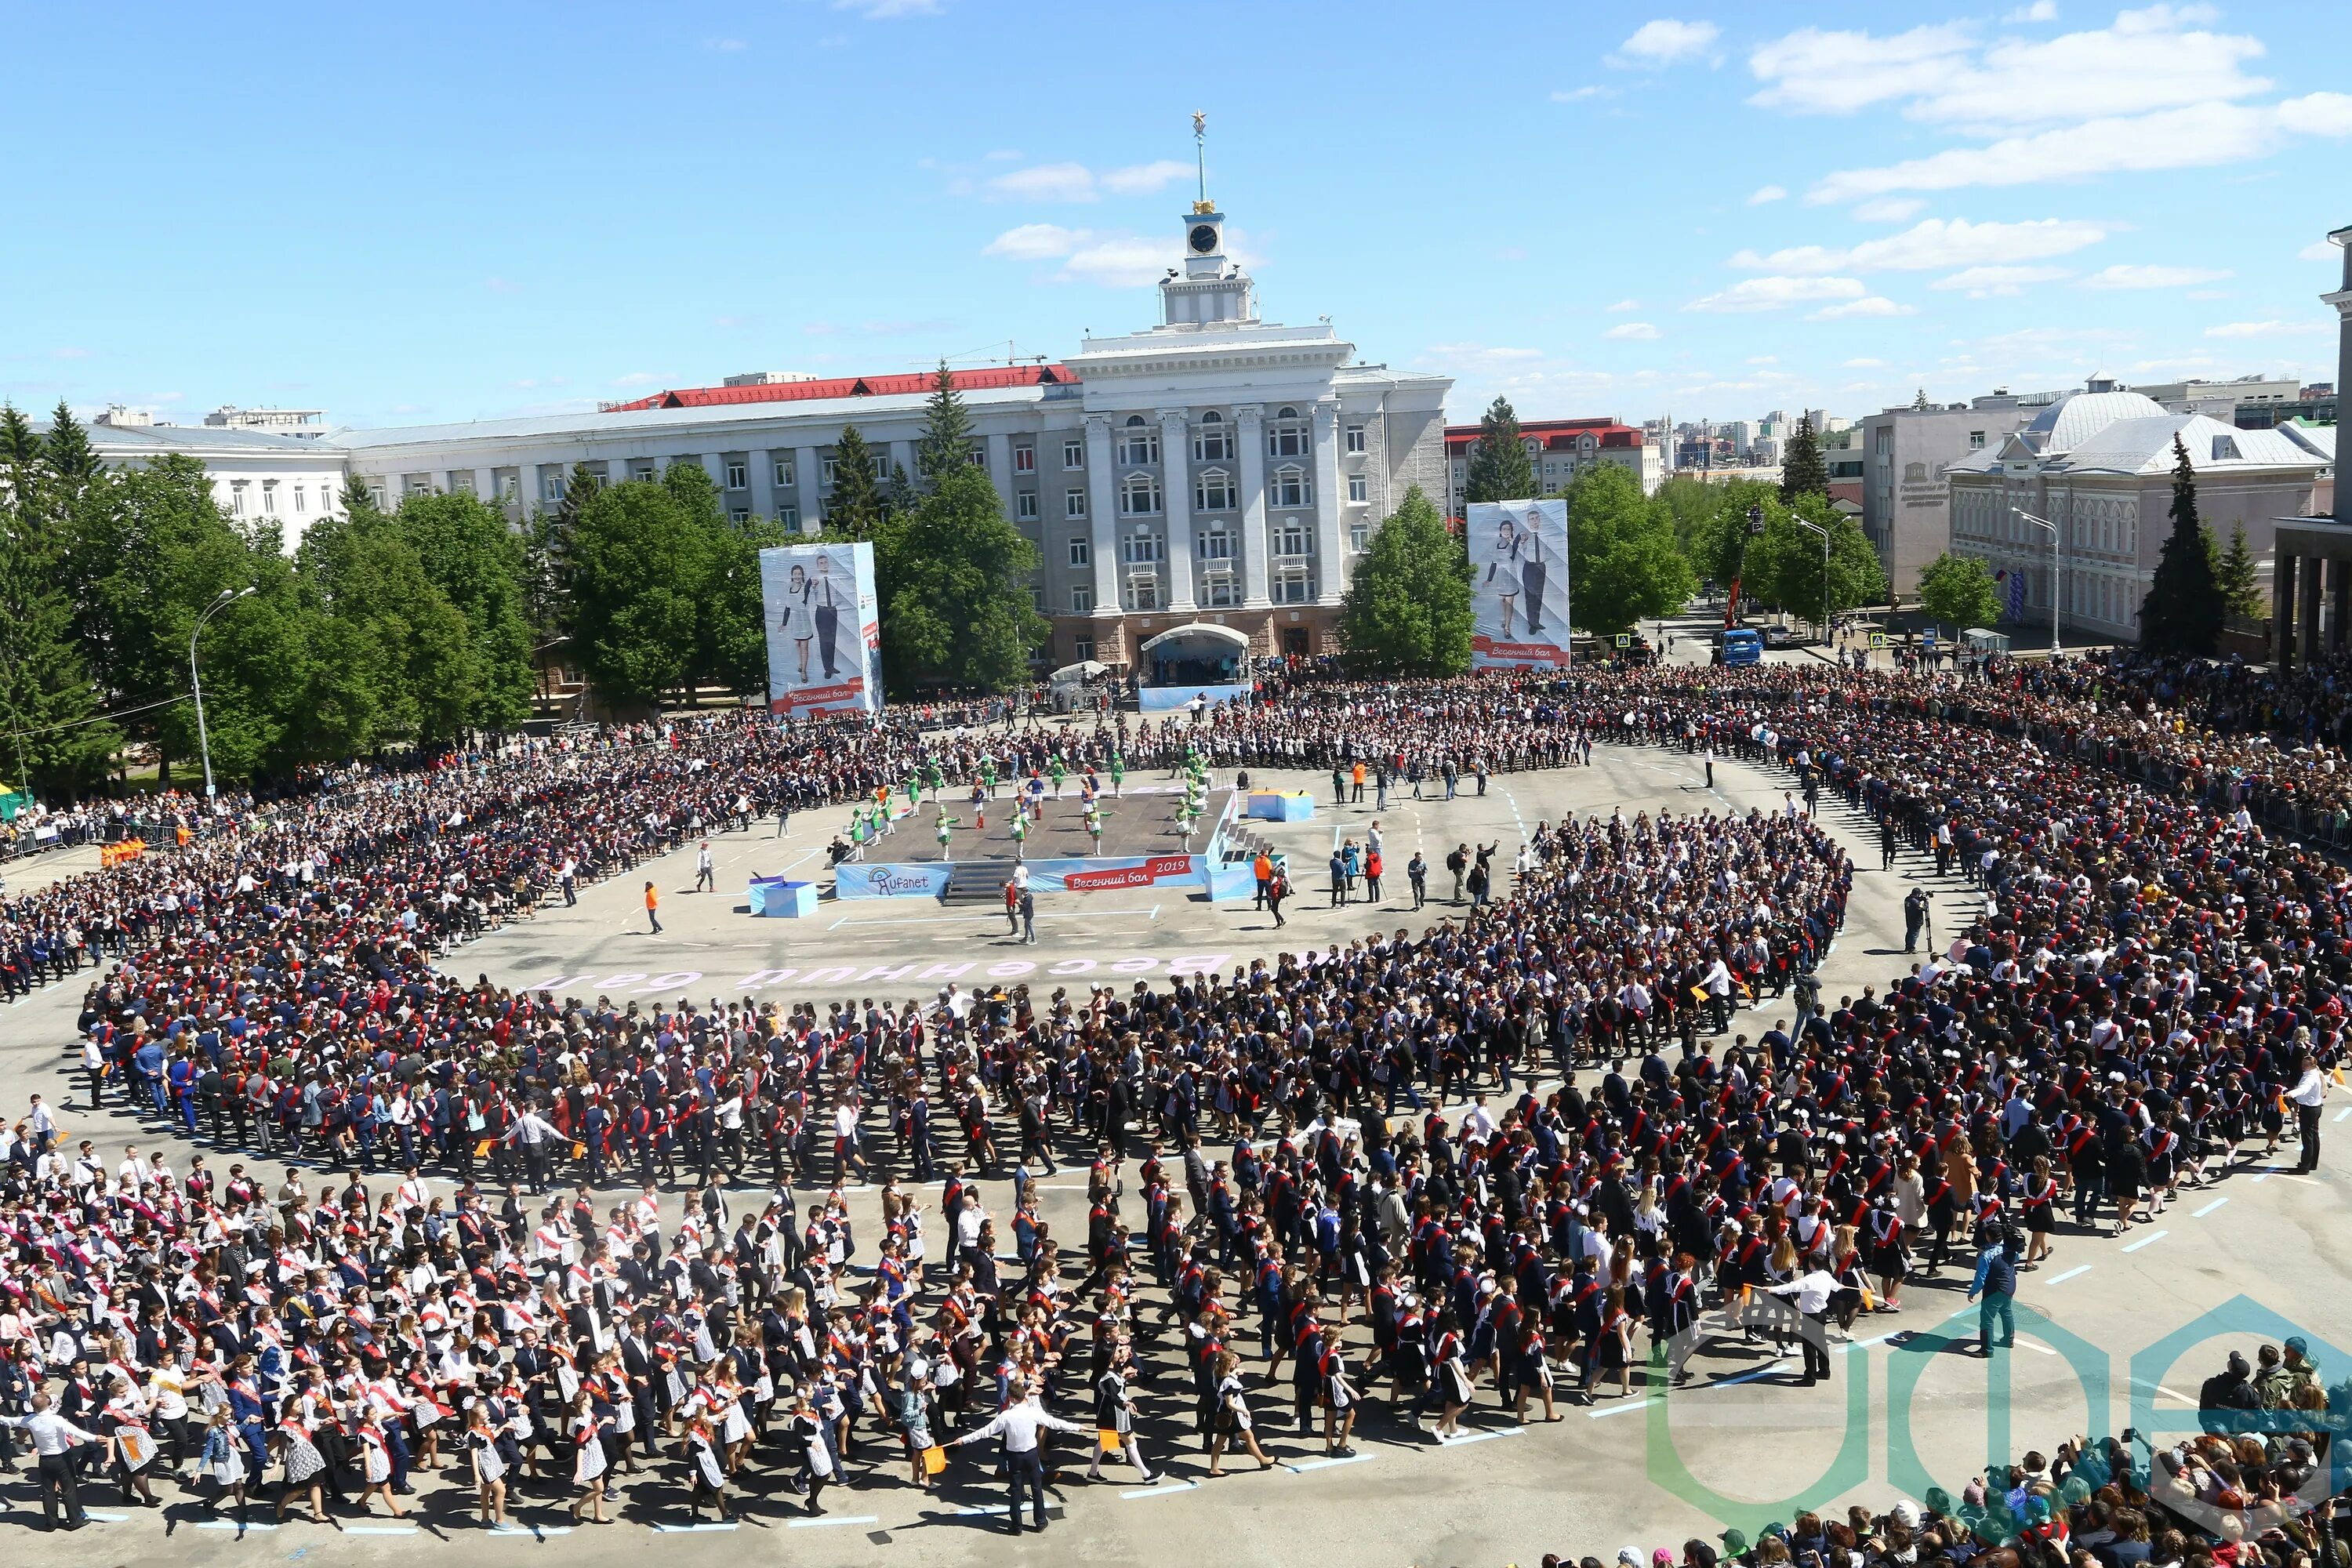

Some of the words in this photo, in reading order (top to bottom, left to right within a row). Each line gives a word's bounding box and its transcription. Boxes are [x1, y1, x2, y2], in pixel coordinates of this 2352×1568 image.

[1493, 647, 1533, 655] Весенний
[1535, 648, 1550, 656] бал
[793, 691, 831, 702] Весенний
[1156, 861, 1185, 873] 2019
[1073, 874, 1125, 889] Весенний
[1128, 872, 1149, 883] бал
[734, 953, 1232, 990] Весенний
[524, 971, 702, 993] бал
